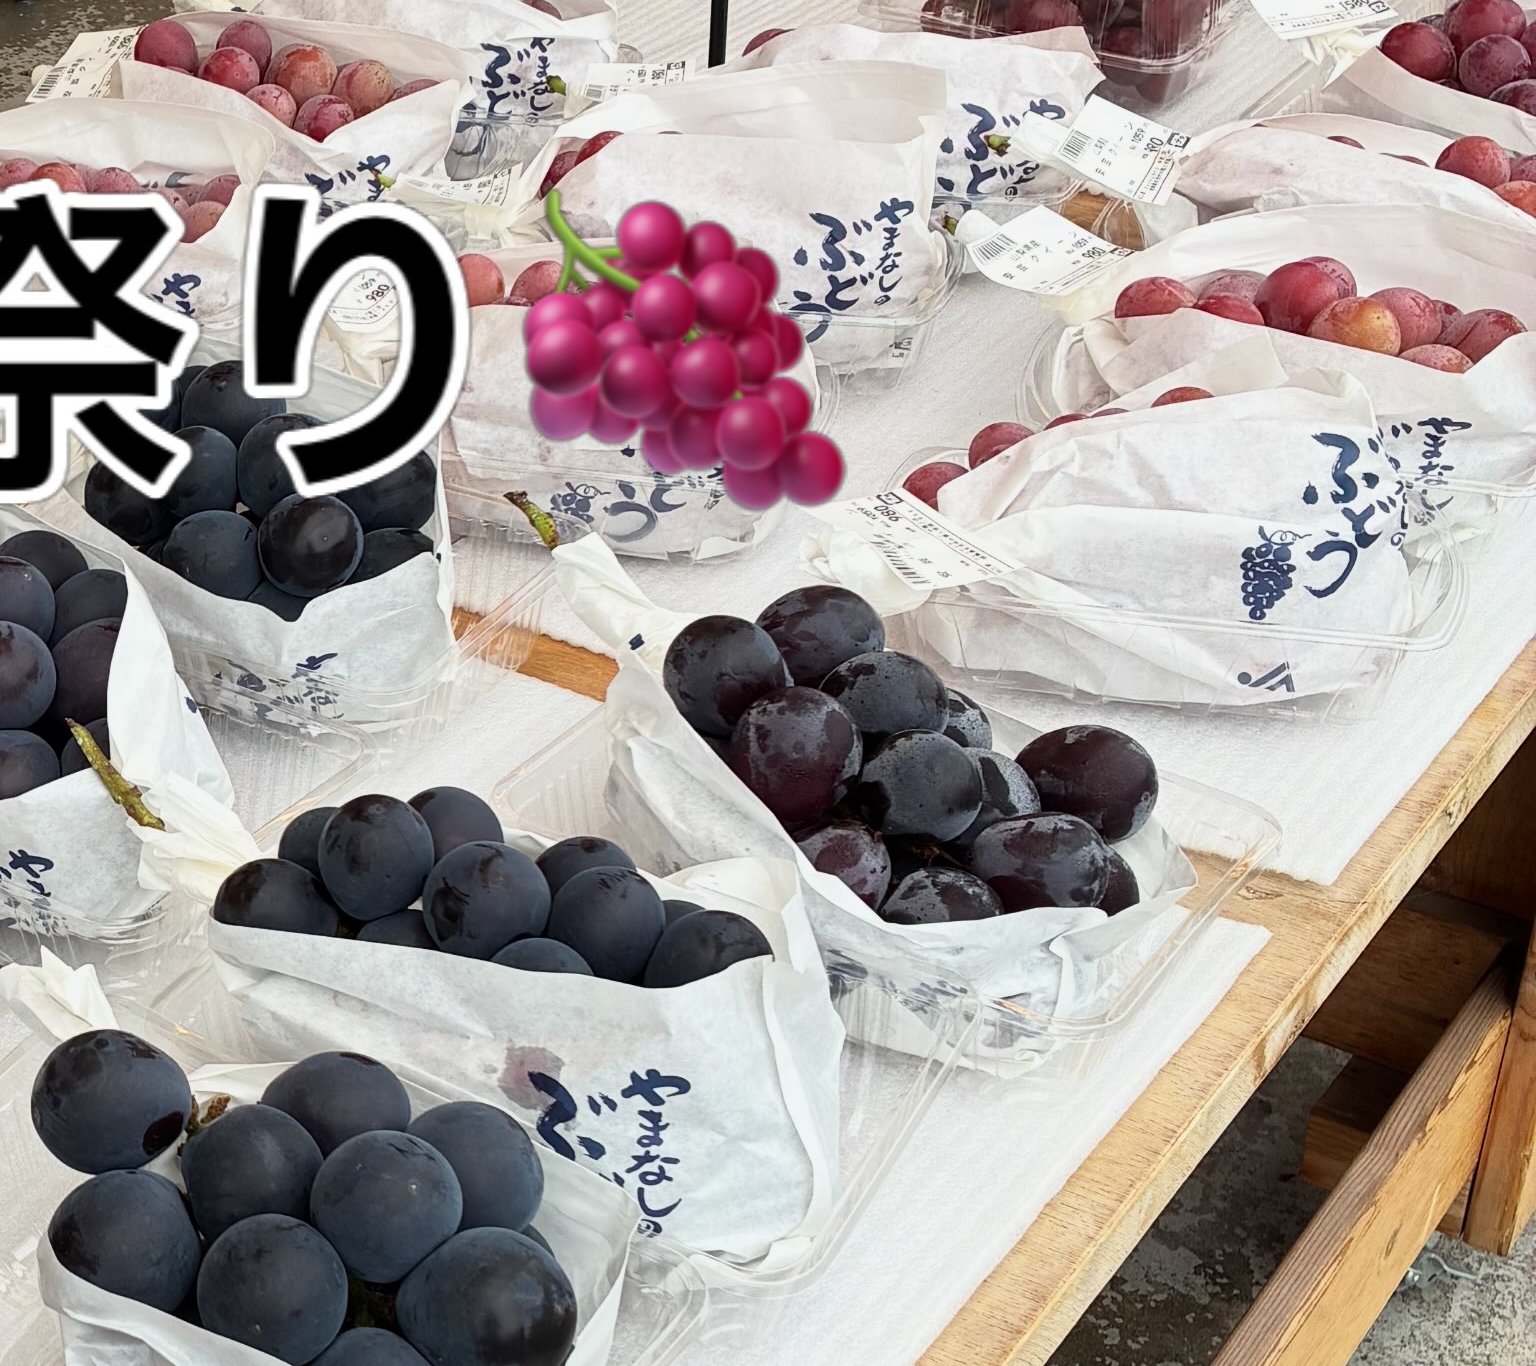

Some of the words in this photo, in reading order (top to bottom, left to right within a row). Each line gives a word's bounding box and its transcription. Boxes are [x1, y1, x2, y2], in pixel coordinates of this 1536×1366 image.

[1129, 127, 1147, 145] 1059
[873, 197, 915, 307] やまなしの
[1081, 246, 1106, 260] 980
[365, 283, 390, 302] 980
[1301, 432, 1398, 599] ぶどう
[620, 1068, 692, 1238] やまなしの
